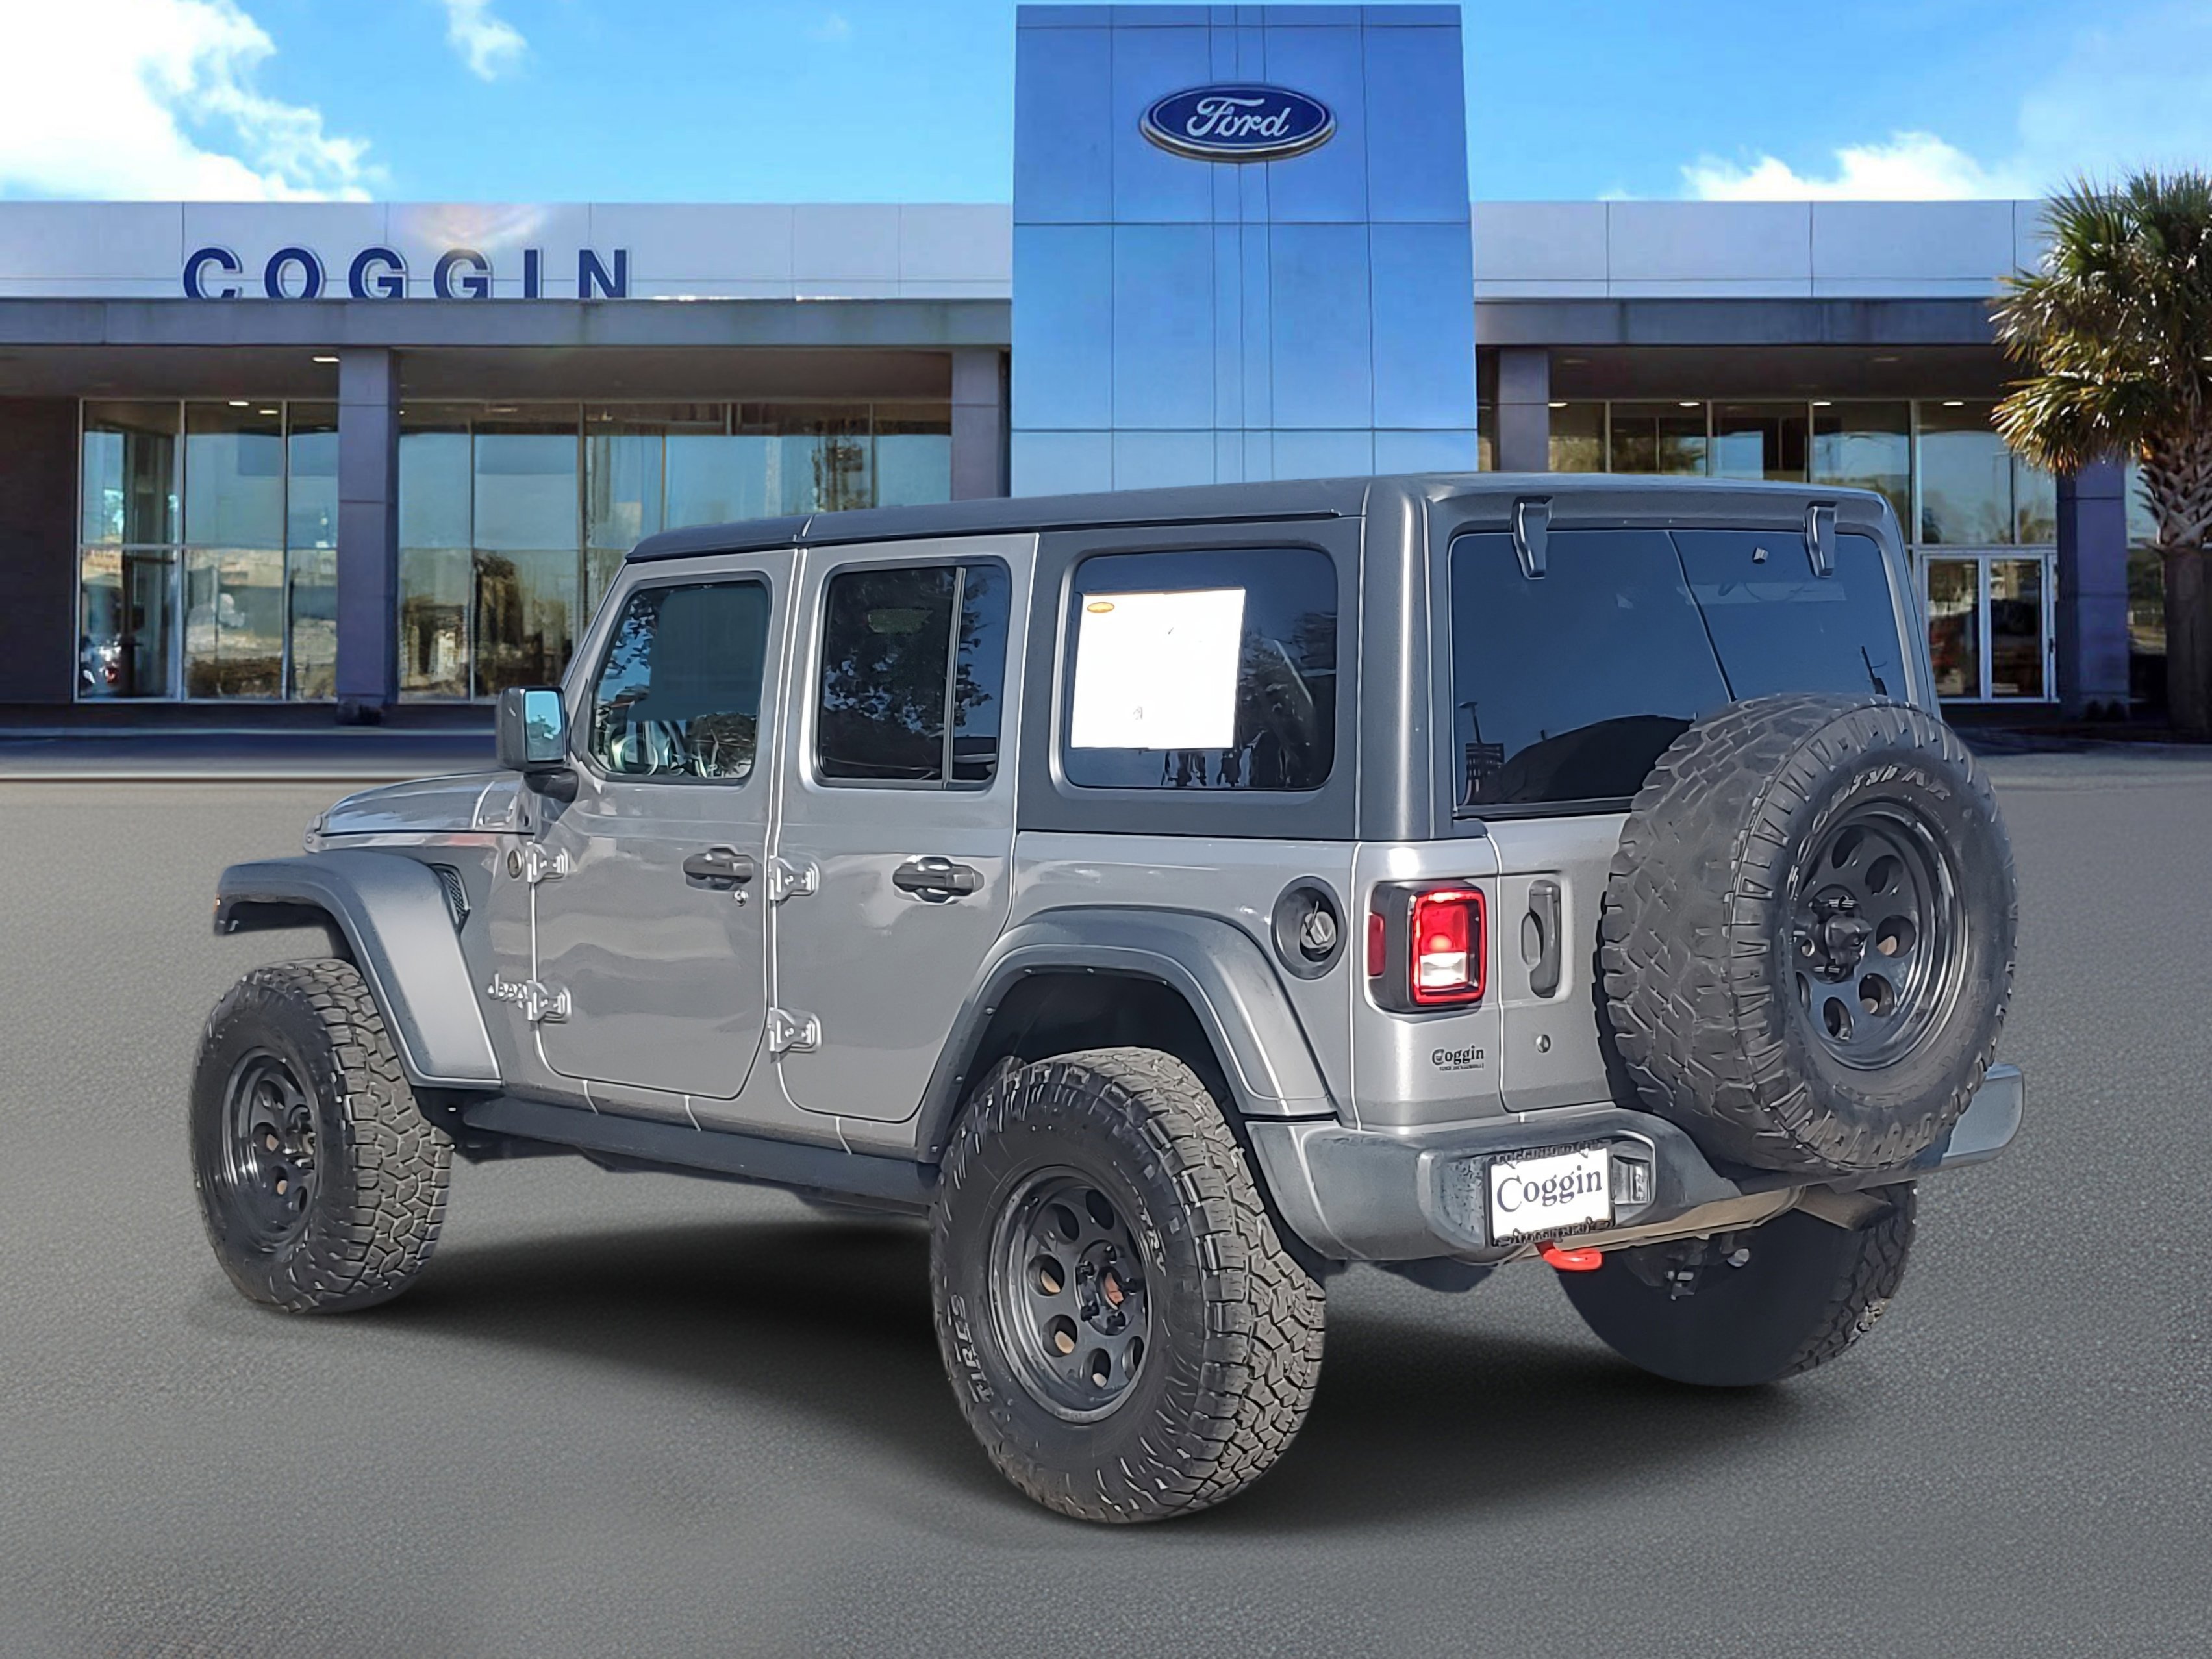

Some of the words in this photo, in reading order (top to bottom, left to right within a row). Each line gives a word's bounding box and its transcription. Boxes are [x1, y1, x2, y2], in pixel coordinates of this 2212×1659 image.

[1187, 97, 1291, 137] Ford
[183, 247, 627, 299] COGGIN
[488, 973, 529, 1009] Jeep
[1432, 1045, 1484, 1065] Coggin
[1497, 1165, 1602, 1213] Coggin
